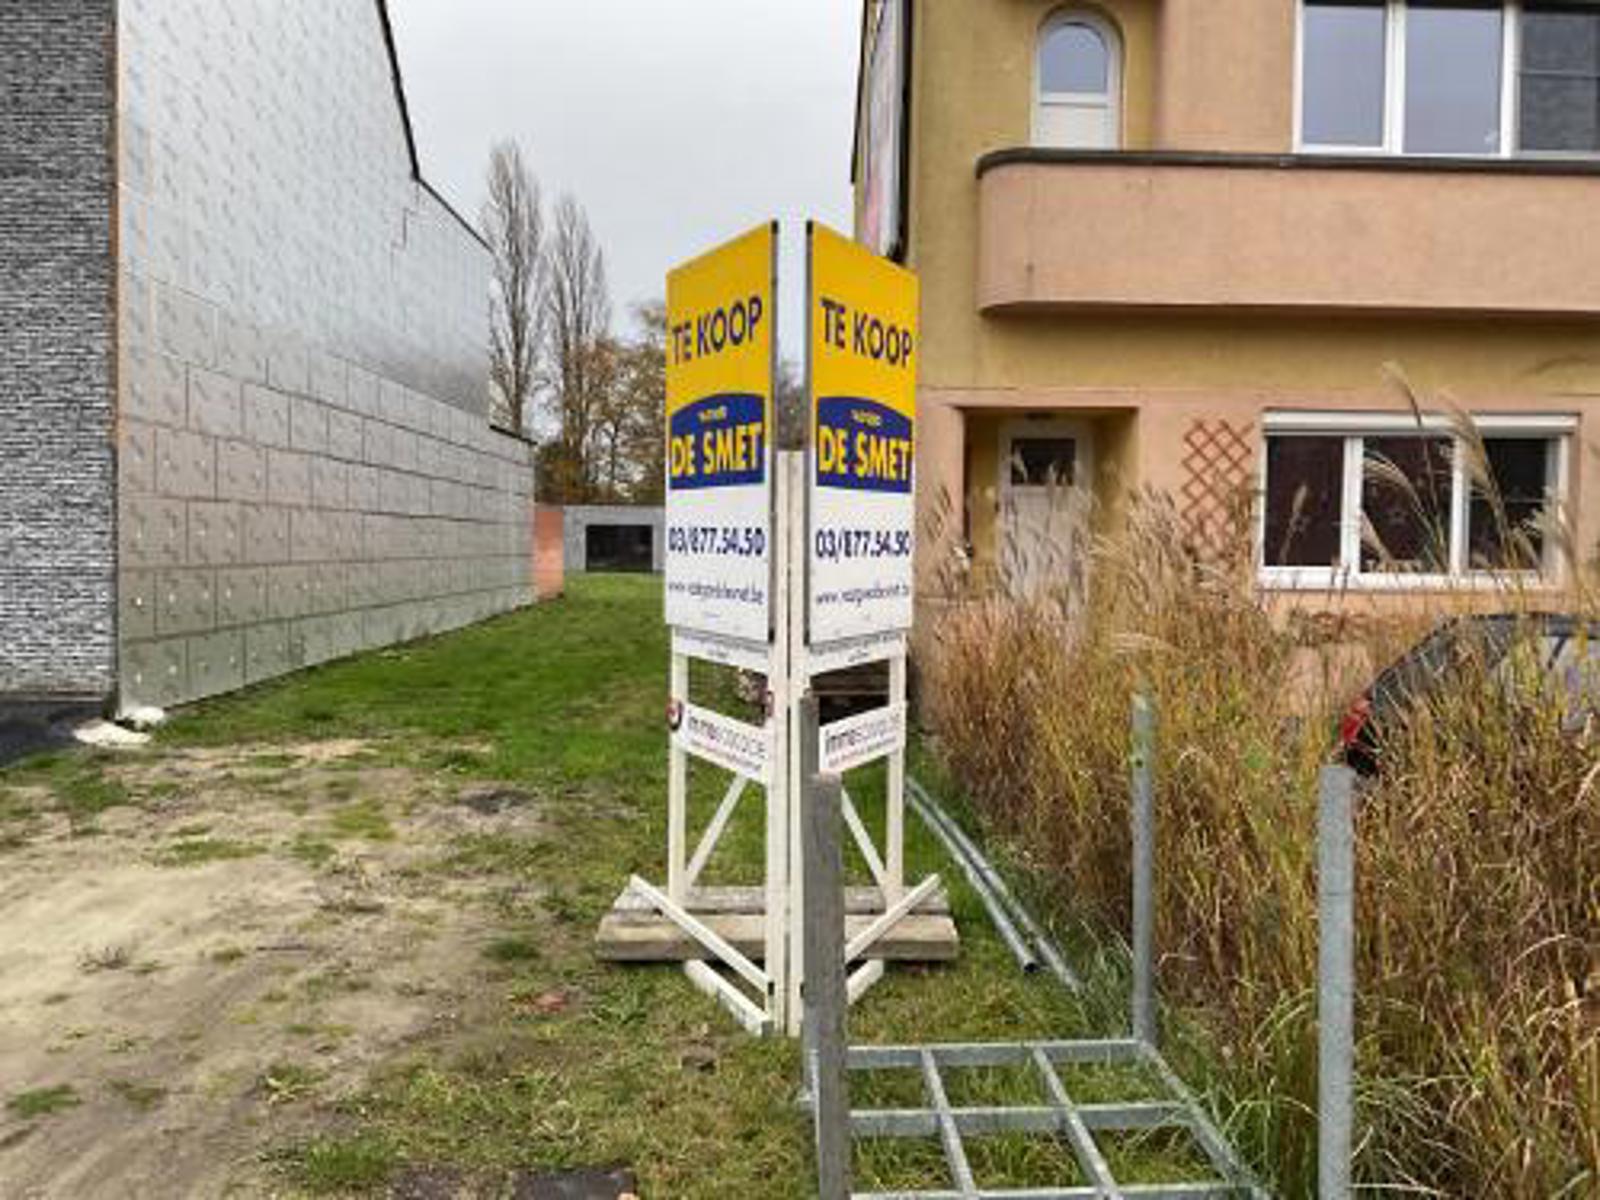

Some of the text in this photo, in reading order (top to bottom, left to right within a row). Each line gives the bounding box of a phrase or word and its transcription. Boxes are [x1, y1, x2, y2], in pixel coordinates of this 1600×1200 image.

[672, 295, 763, 366] TE KOOP
[820, 297, 913, 369] TE KOOP
[671, 422, 763, 477] DE SMET
[818, 425, 910, 481] DE SMET
[668, 526, 765, 557] 03/877.54.50
